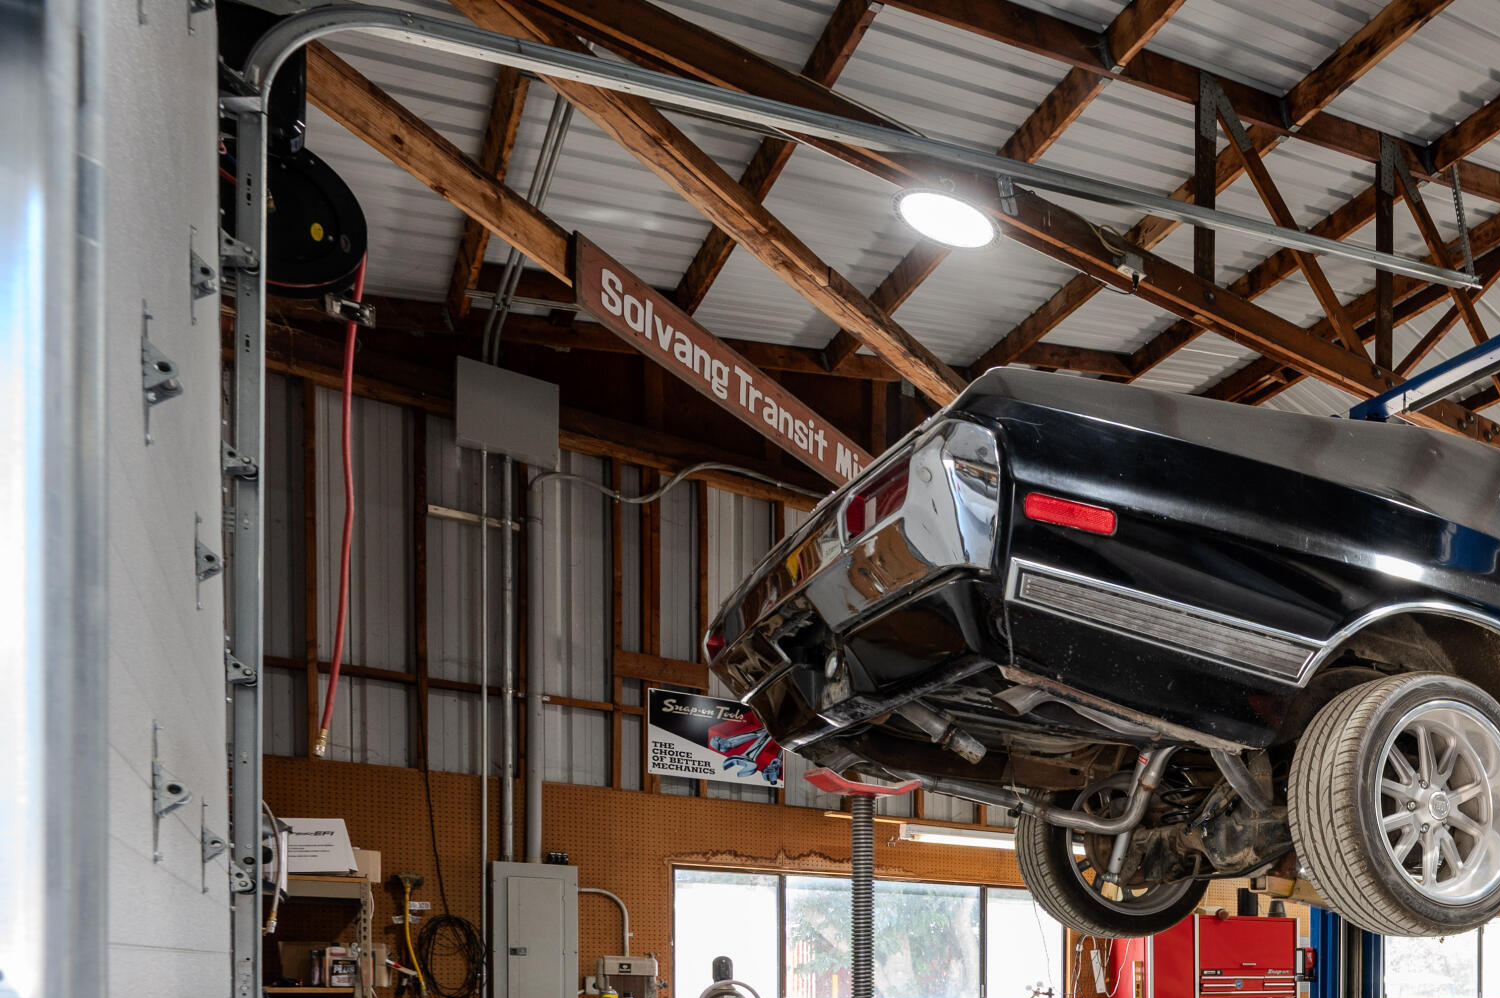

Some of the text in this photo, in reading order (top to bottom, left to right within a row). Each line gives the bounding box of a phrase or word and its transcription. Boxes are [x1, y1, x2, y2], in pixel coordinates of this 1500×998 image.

[600, 267, 730, 401] Solvang
[734, 363, 828, 463] Transit
[661, 698, 744, 721] Snap-on Tools
[651, 740, 675, 750] THE
[652, 748, 693, 759] CHOICE
[652, 755, 712, 768] OF BETTER
[652, 761, 716, 775] MECHANICS
